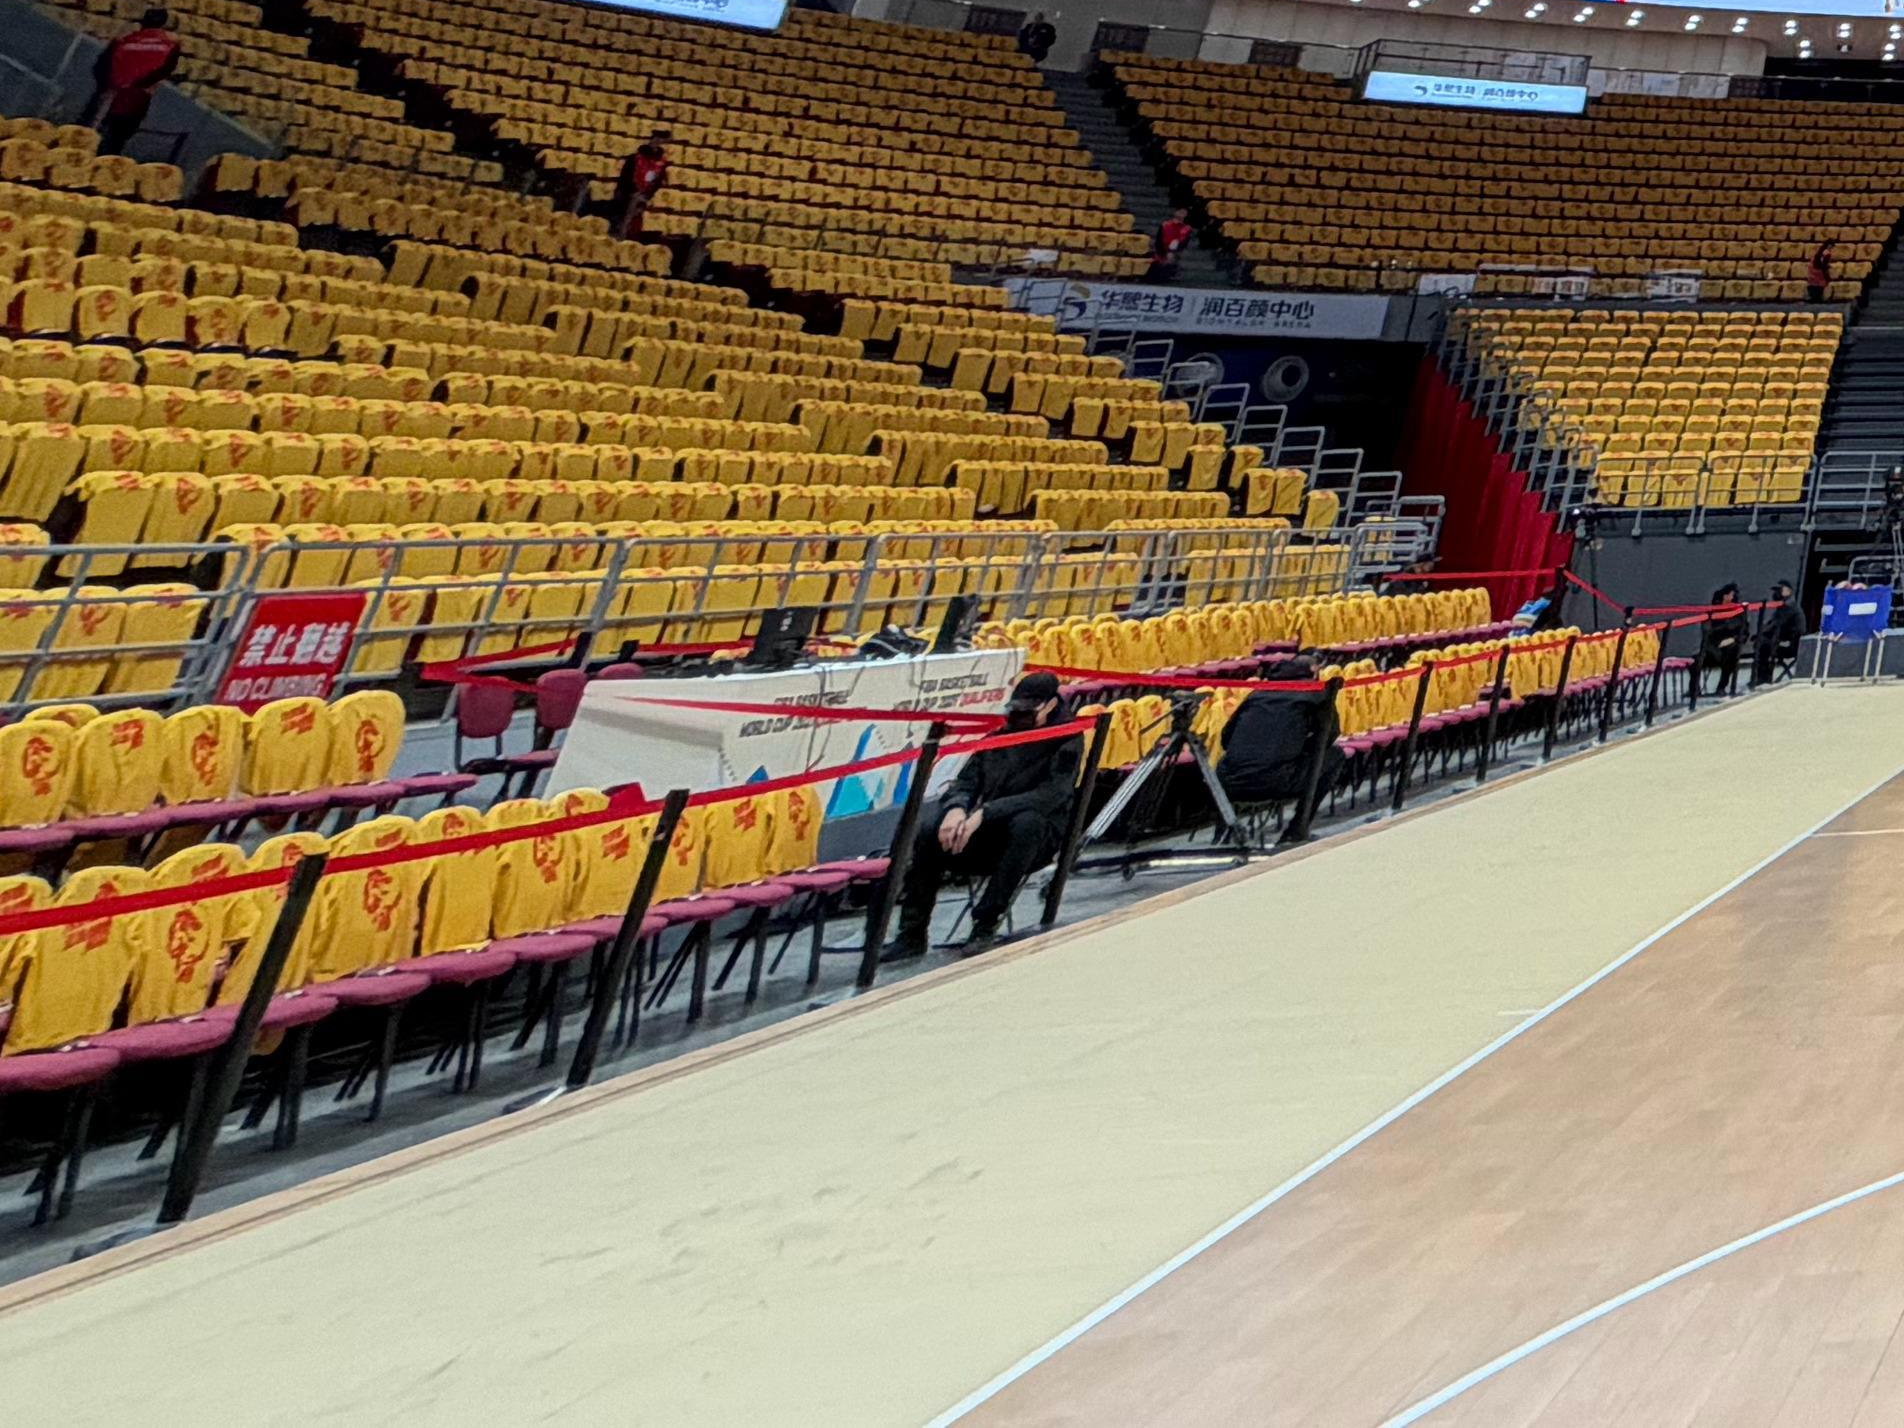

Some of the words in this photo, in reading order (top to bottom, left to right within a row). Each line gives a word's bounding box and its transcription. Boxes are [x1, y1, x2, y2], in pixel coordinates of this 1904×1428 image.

[1101, 289, 1184, 314] 华熙生物
[1200, 296, 1315, 321] 润百颜中心
[238, 621, 351, 667] 禁止翻越
[224, 678, 252, 702] NO
